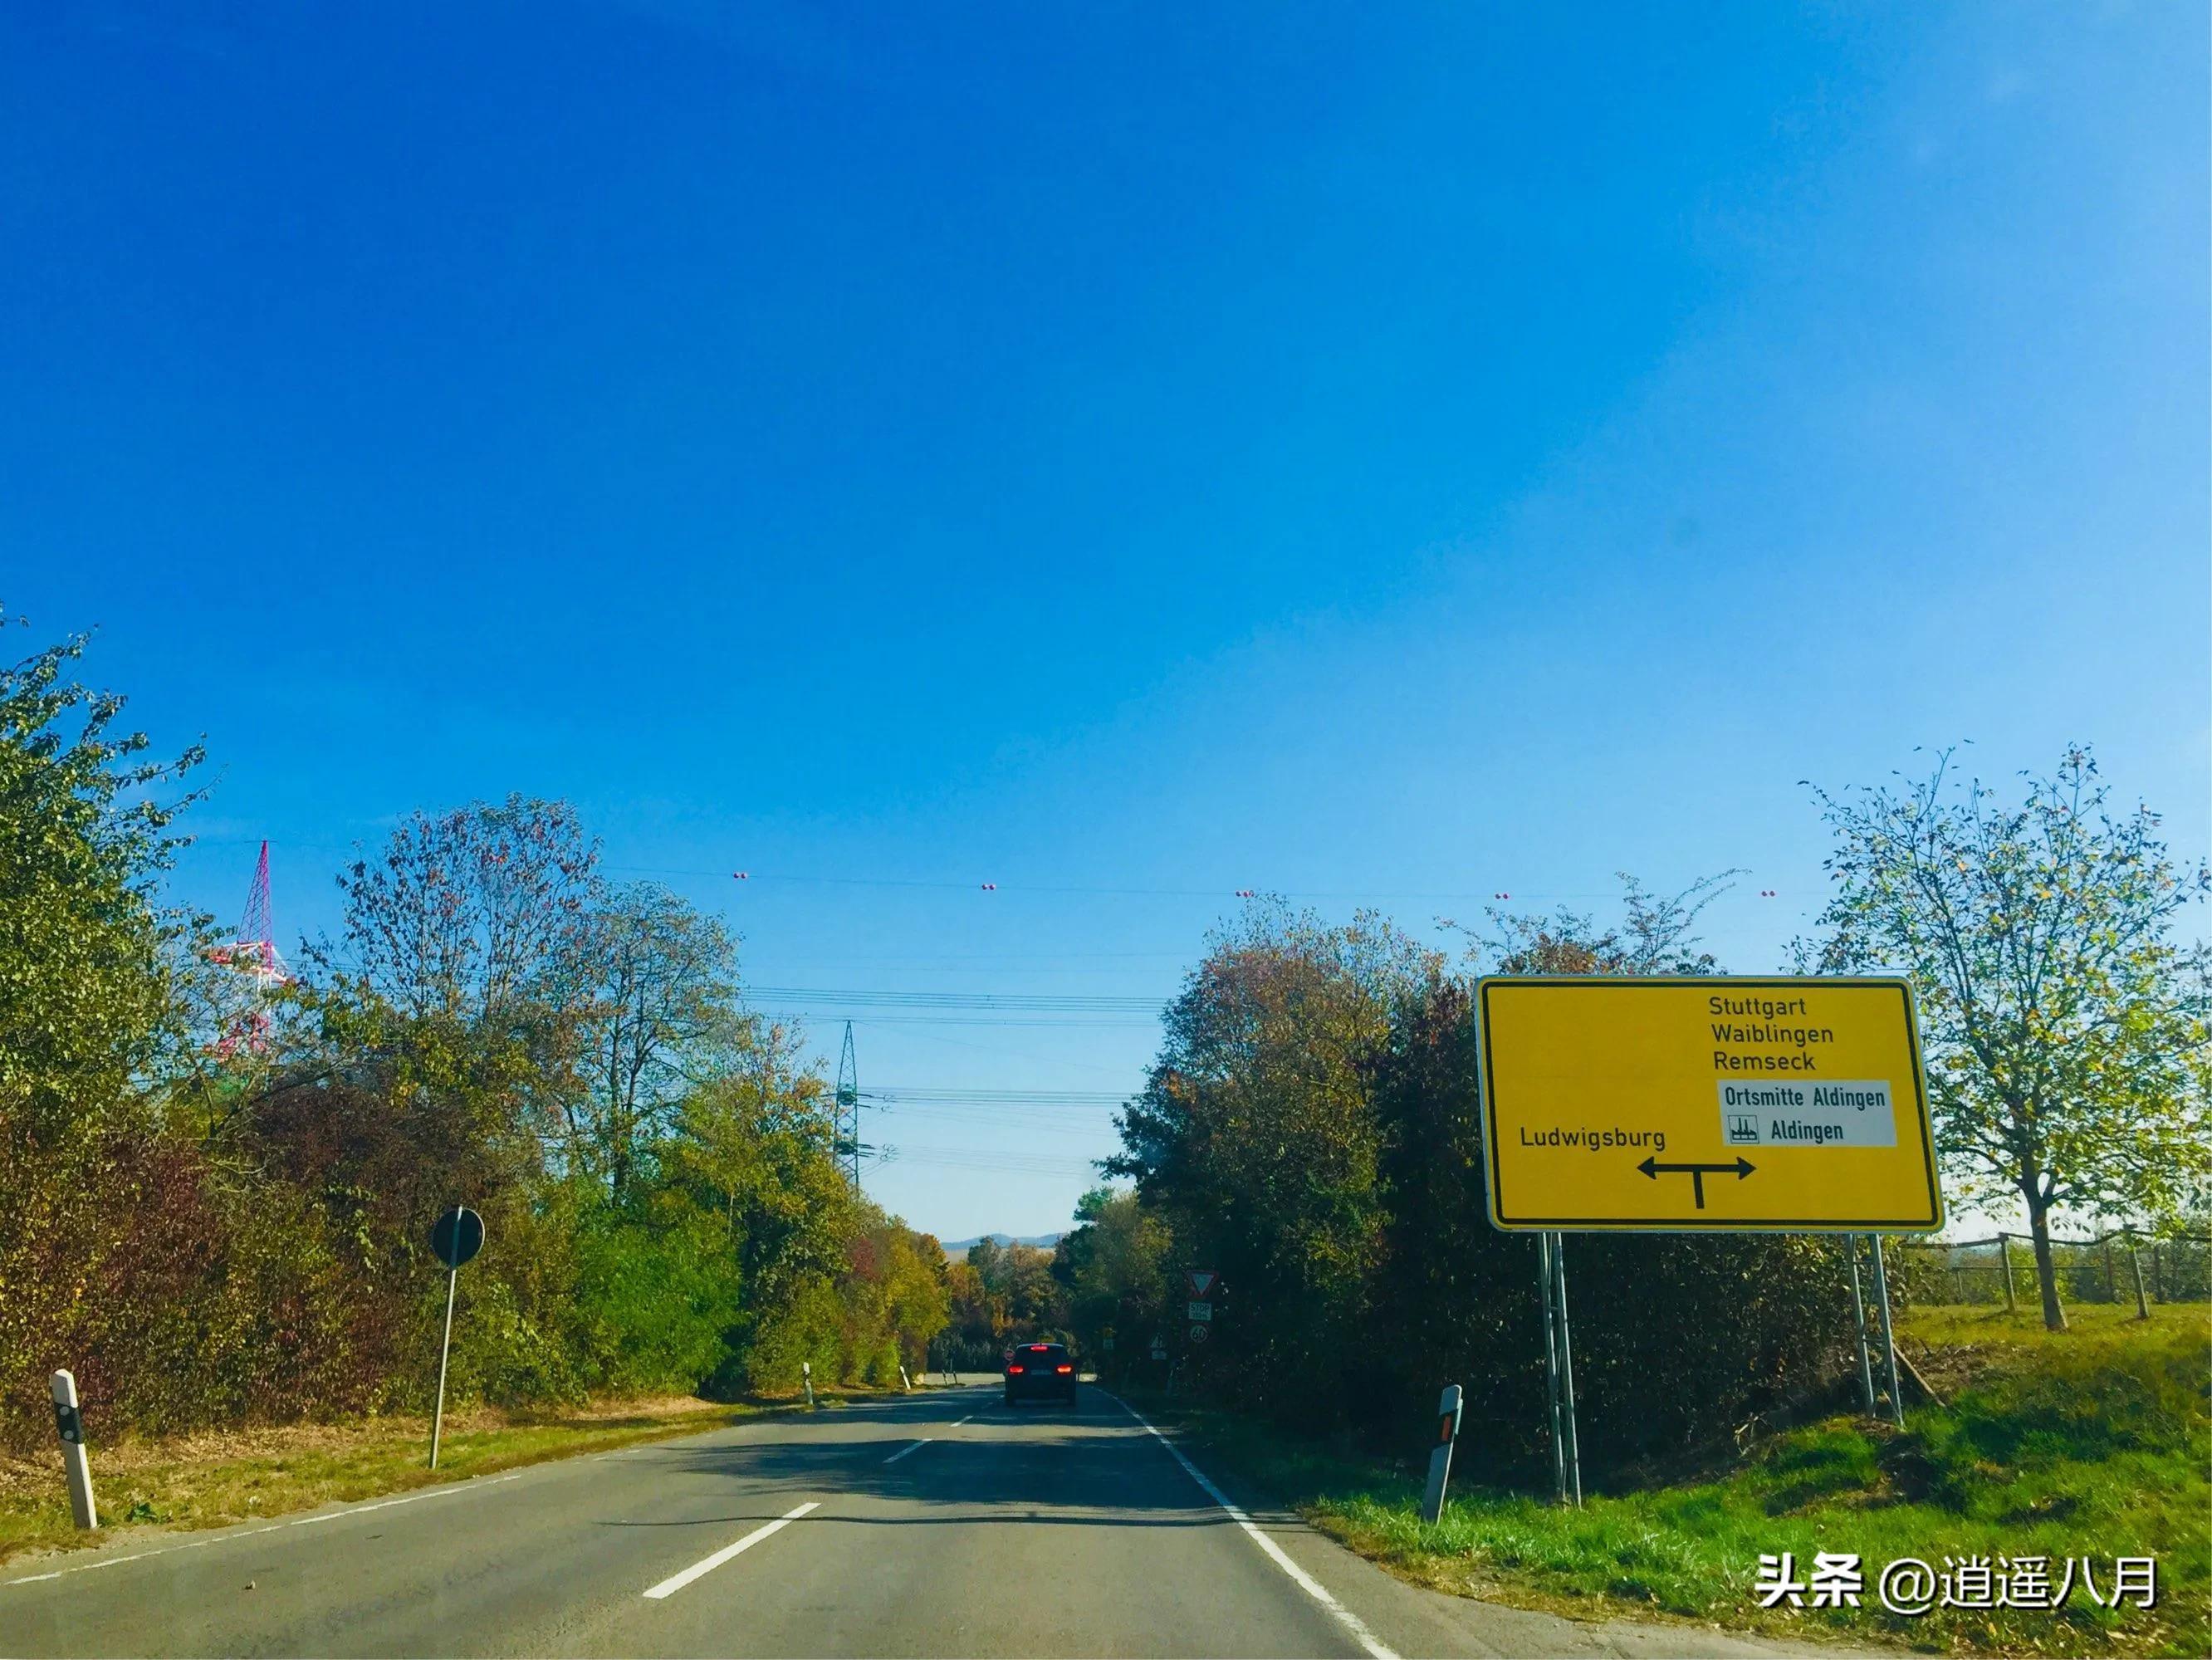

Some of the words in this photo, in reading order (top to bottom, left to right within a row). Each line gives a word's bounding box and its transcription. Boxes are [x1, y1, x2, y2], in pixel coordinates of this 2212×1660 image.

[1709, 996, 1807, 1021] Stuttgart
[1710, 1023, 1833, 1048] Waiblingen
[1714, 1050, 1816, 1070] Remseck
[1725, 1086, 1803, 1107] Ortsmitte
[1813, 1087, 1886, 1112] Aldingen
[1520, 1126, 1666, 1153] Ludwigsburg
[1771, 1119, 1844, 1145] Aldingen
[1191, 1302, 1209, 1312] STOP
